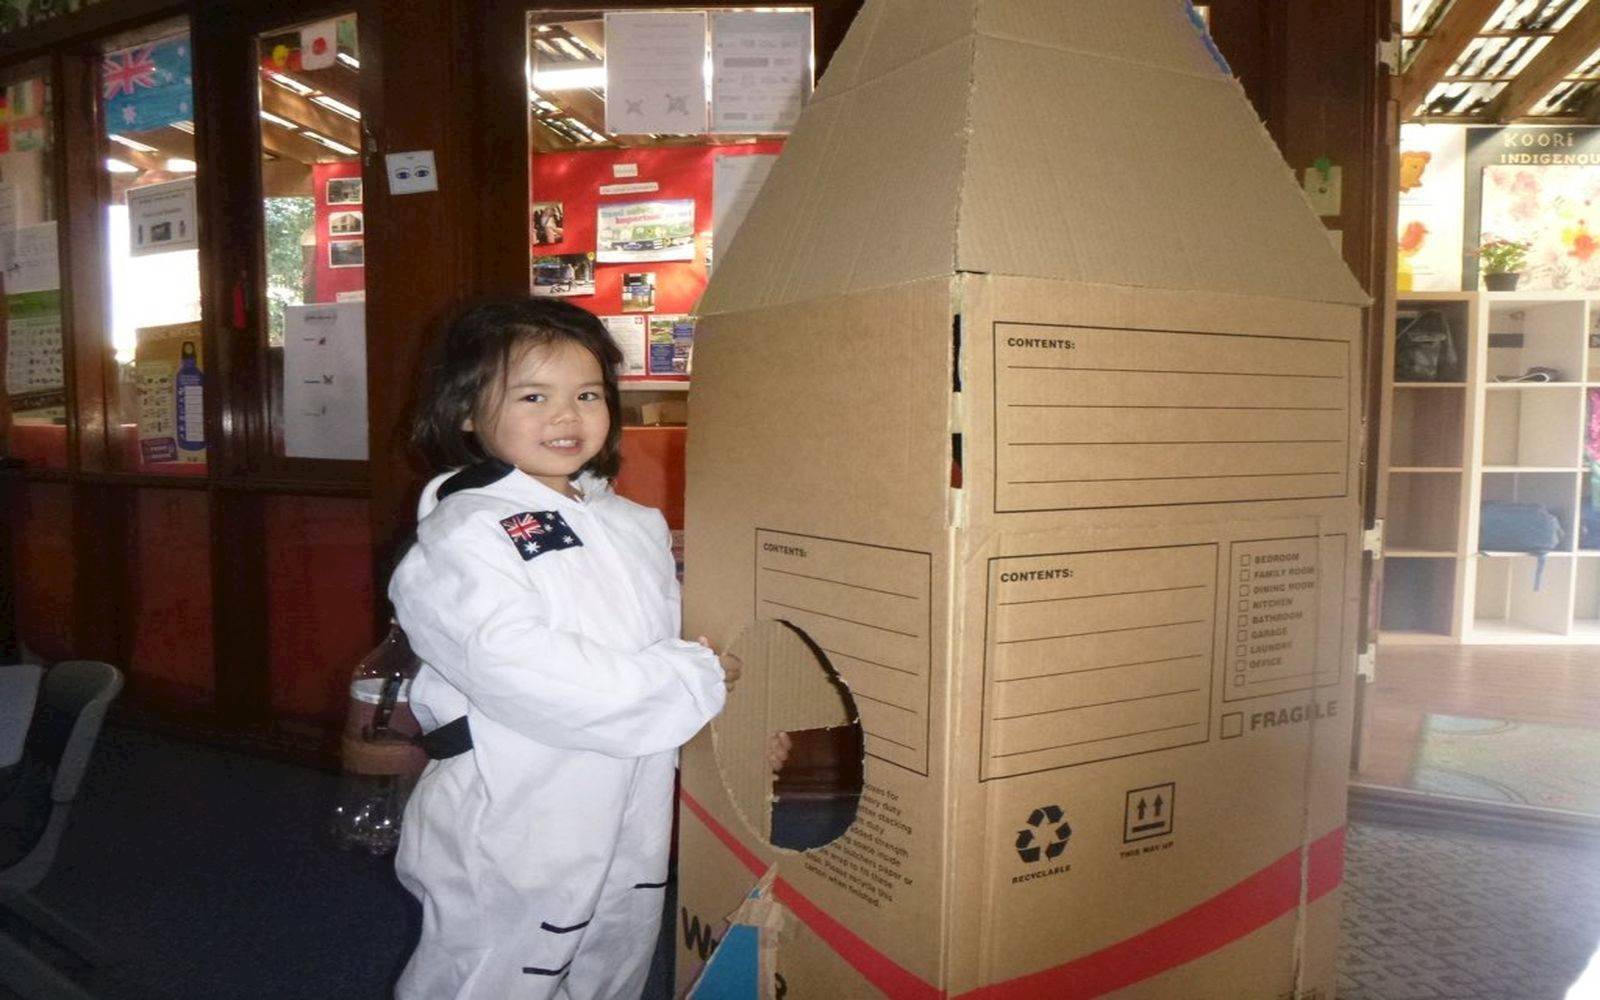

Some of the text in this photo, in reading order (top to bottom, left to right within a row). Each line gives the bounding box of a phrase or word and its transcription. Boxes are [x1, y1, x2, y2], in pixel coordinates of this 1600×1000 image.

[1007, 337, 1076, 350] CONTENTS:
[763, 542, 808, 558] CONTENTS:
[1254, 552, 1300, 564] BEDROOM
[1000, 568, 1074, 583] CONTENTS:
[1254, 566, 1315, 579] FAMILY ROOM
[1253, 581, 1314, 595] DINING ROOM
[1253, 598, 1293, 609] KITCHEN
[1252, 611, 1303, 625] BATHROOM
[1251, 627, 1288, 639] GARAGE
[1249, 657, 1282, 669] OFFICE
[1250, 700, 1338, 732] FRAGILE
[1120, 849, 1140, 860] THIS
[1143, 844, 1160, 853] WAY
[1011, 864, 1073, 885] RECYCLABLE
